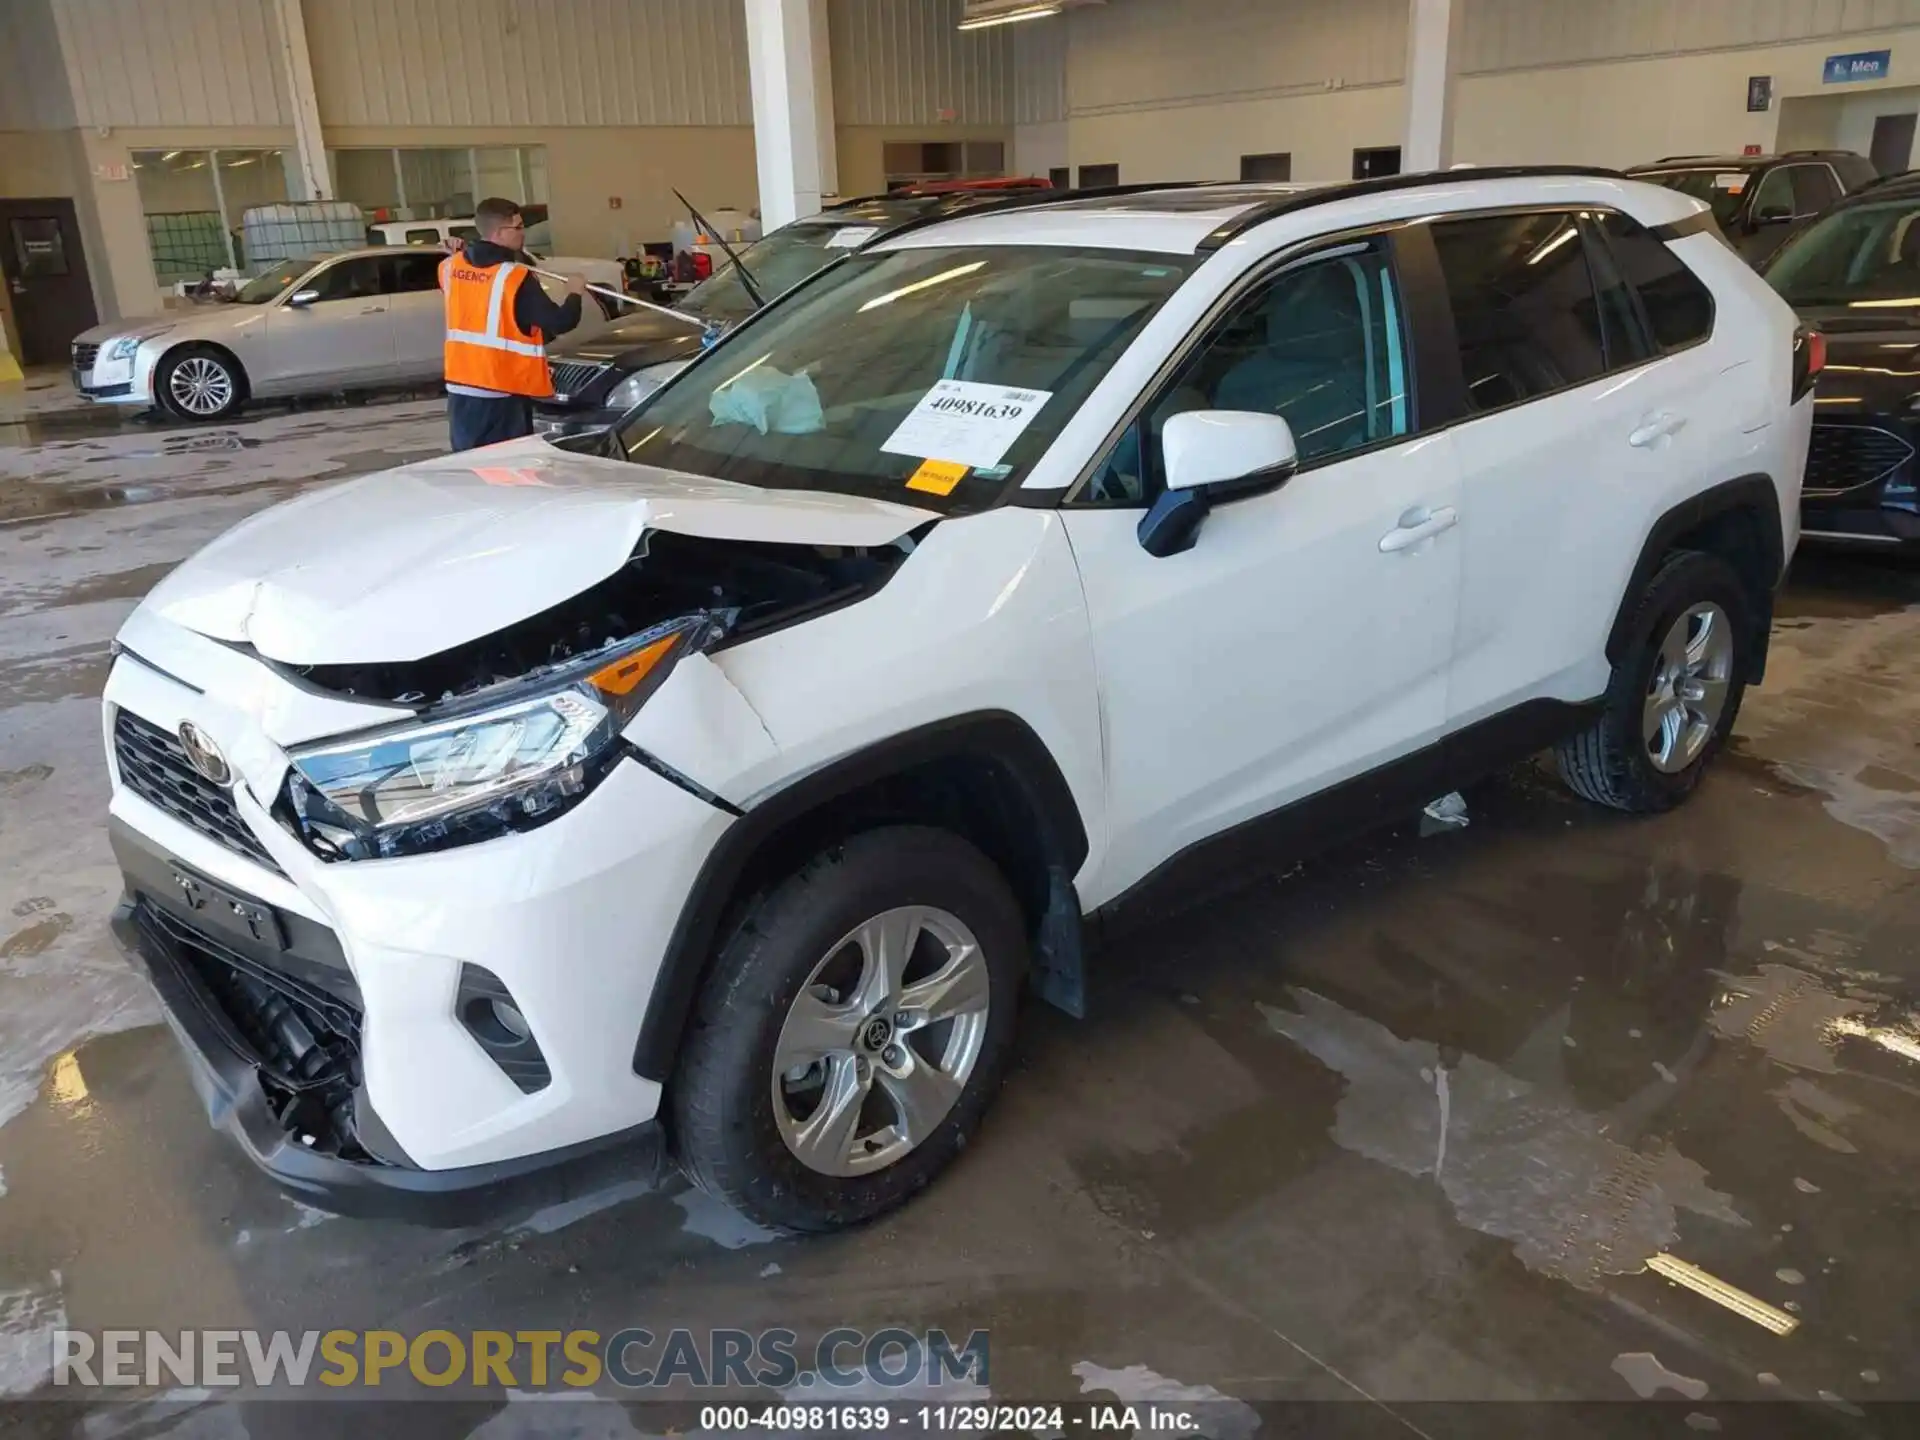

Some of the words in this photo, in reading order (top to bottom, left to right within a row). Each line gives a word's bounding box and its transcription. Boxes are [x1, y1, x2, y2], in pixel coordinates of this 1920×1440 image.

[1851, 60, 1879, 73] Men
[452, 268, 493, 283] AGENCY
[930, 396, 1022, 420] 40981639
